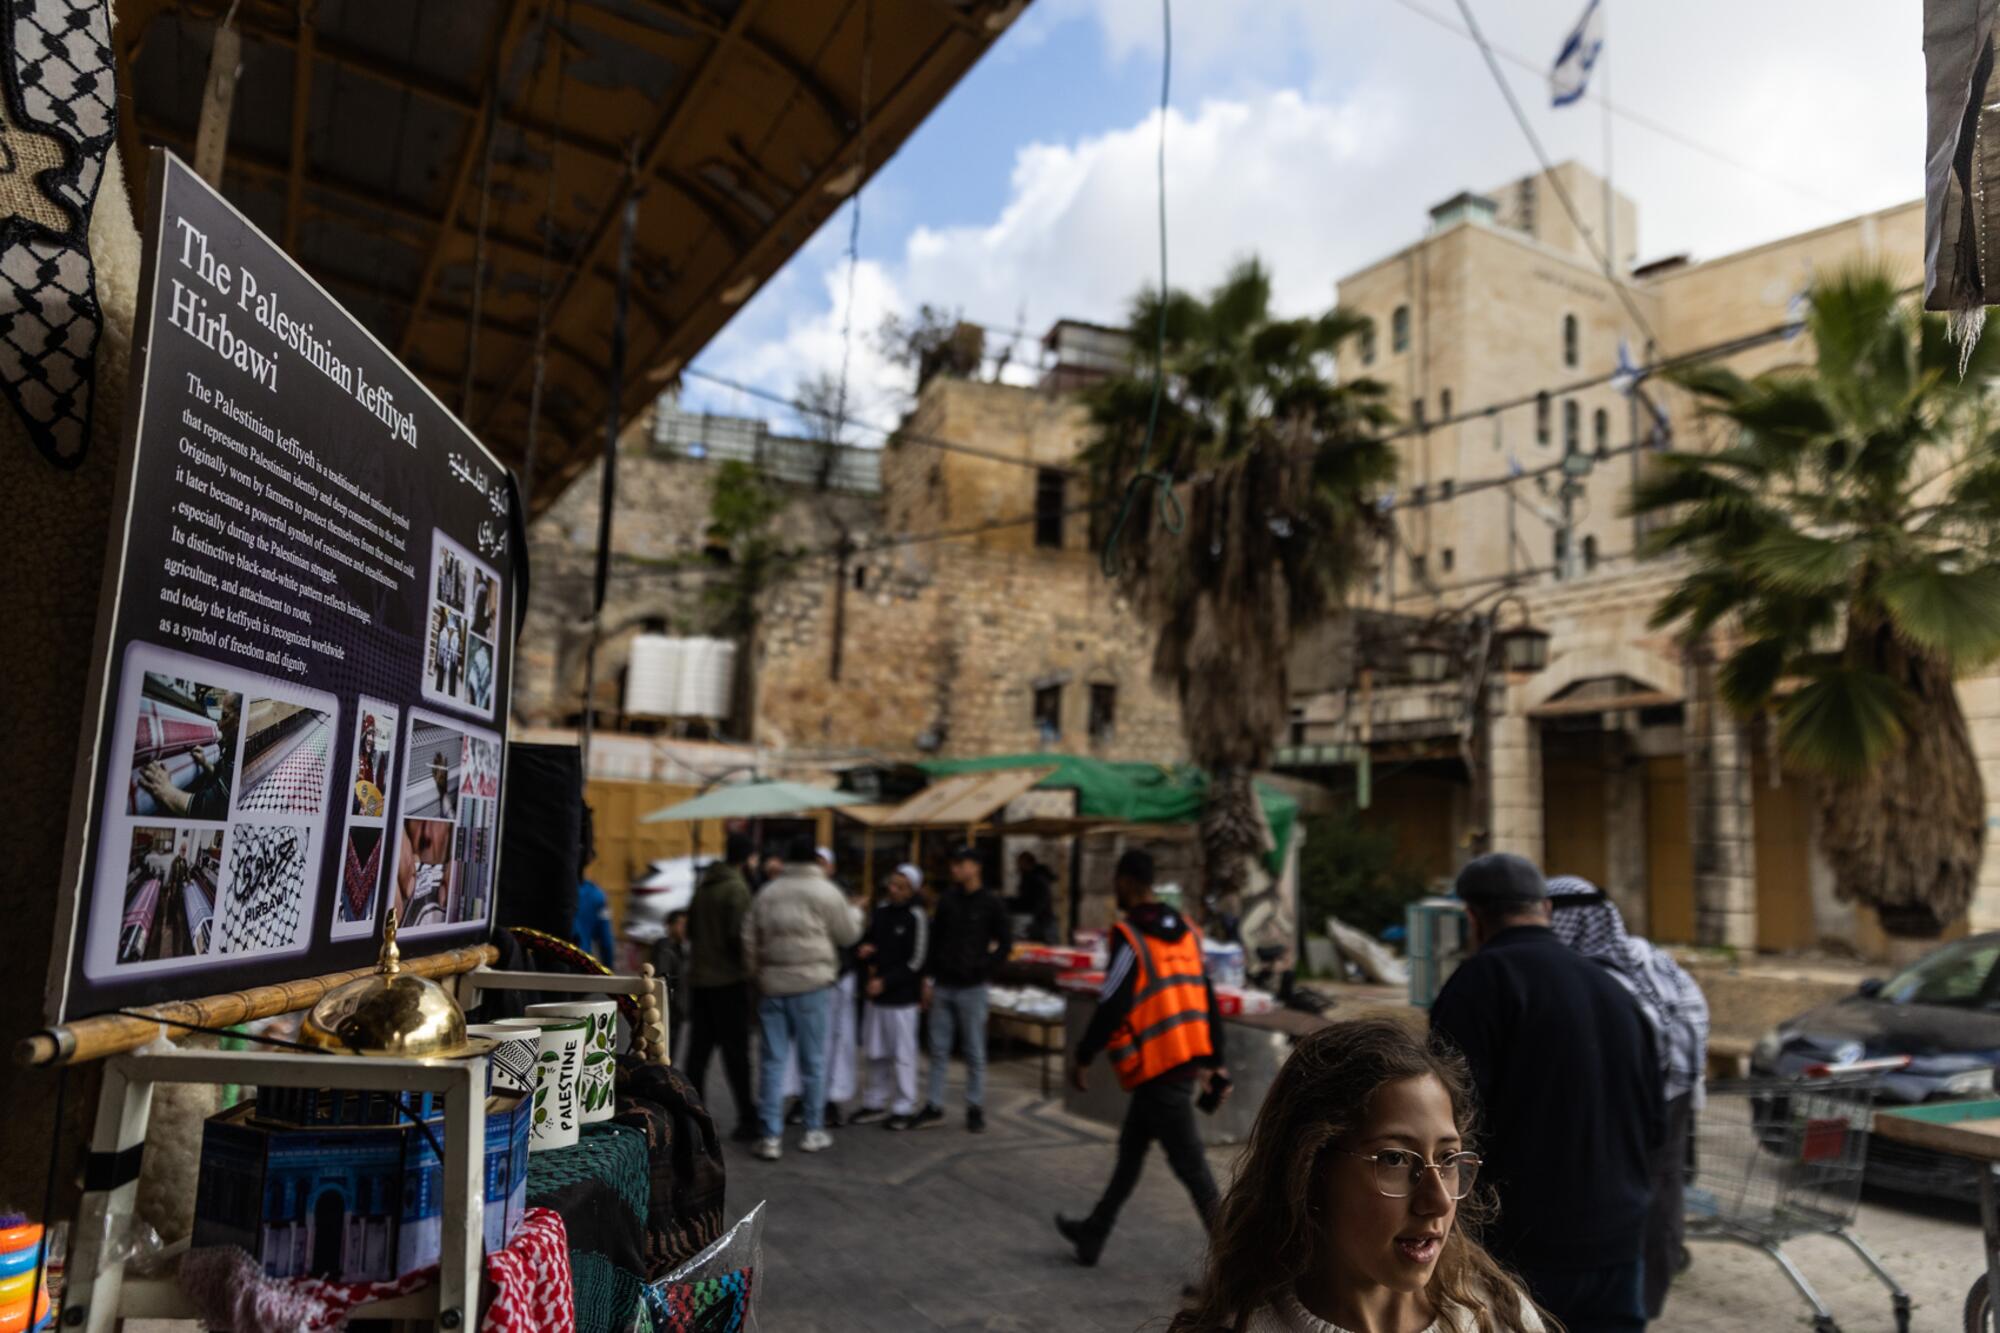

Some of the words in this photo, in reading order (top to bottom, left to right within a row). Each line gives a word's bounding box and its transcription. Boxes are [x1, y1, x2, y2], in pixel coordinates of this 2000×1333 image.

[168, 278, 278, 393] Hirbawi
[177, 216, 231, 295] The
[237, 267, 352, 395] Palestinian
[355, 367, 417, 449] keffiyeh
[182, 408, 202, 431] that
[203, 422, 248, 458] represents
[249, 446, 292, 483] Palestinian
[292, 472, 320, 501] identity
[320, 492, 332, 507] and
[332, 497, 348, 518] deep
[187, 372, 212, 404] The
[214, 389, 274, 443] Palestinian
[276, 429, 315, 469] keffiyeh
[316, 458, 322, 474] is
[323, 466, 328, 477] a
[328, 469, 359, 497] traditional
[175, 464, 184, 483] it
[185, 470, 208, 494] later
[209, 481, 244, 511] became
[244, 504, 250, 515] a
[251, 507, 287, 534] powerful
[287, 525, 314, 547] symbol
[314, 538, 323, 552] of
[322, 545, 353, 567] resistance
[178, 501, 226, 535] especially
[227, 521, 255, 549] during
[257, 535, 270, 552] the
[270, 540, 309, 571] Palestinian
[179, 436, 228, 478] Originally
[229, 467, 251, 488] worn
[253, 474, 264, 496] by
[265, 483, 294, 511] farmers
[295, 501, 302, 515] to
[303, 507, 327, 529] protect
[327, 519, 360, 548] themselves
[164, 558, 220, 591] agriculture,
[221, 580, 238, 595] and
[239, 586, 282, 612] attachment
[283, 602, 291, 615] to
[292, 607, 312, 626] roots,
[171, 525, 185, 545] Its
[187, 532, 235, 565] distinctive
[236, 552, 298, 592] black-and-white
[298, 584, 323, 603] pattern
[323, 594, 347, 613] reflects
[160, 588, 180, 604] and
[181, 593, 209, 617] today
[210, 601, 225, 619] the
[226, 606, 261, 632] keffiyeh
[262, 618, 270, 634] is
[270, 625, 311, 648] recognized
[311, 639, 345, 660] worldwide
[160, 618, 171, 633] as
[173, 623, 180, 635] a
[181, 625, 217, 646] symbol
[218, 634, 230, 649] of
[230, 636, 264, 660] freedom
[266, 650, 280, 665] and
[280, 653, 308, 676] dignity.
[245, 886, 288, 921] HIRBAWI
[558, 1040, 578, 1131] PALESTINE
